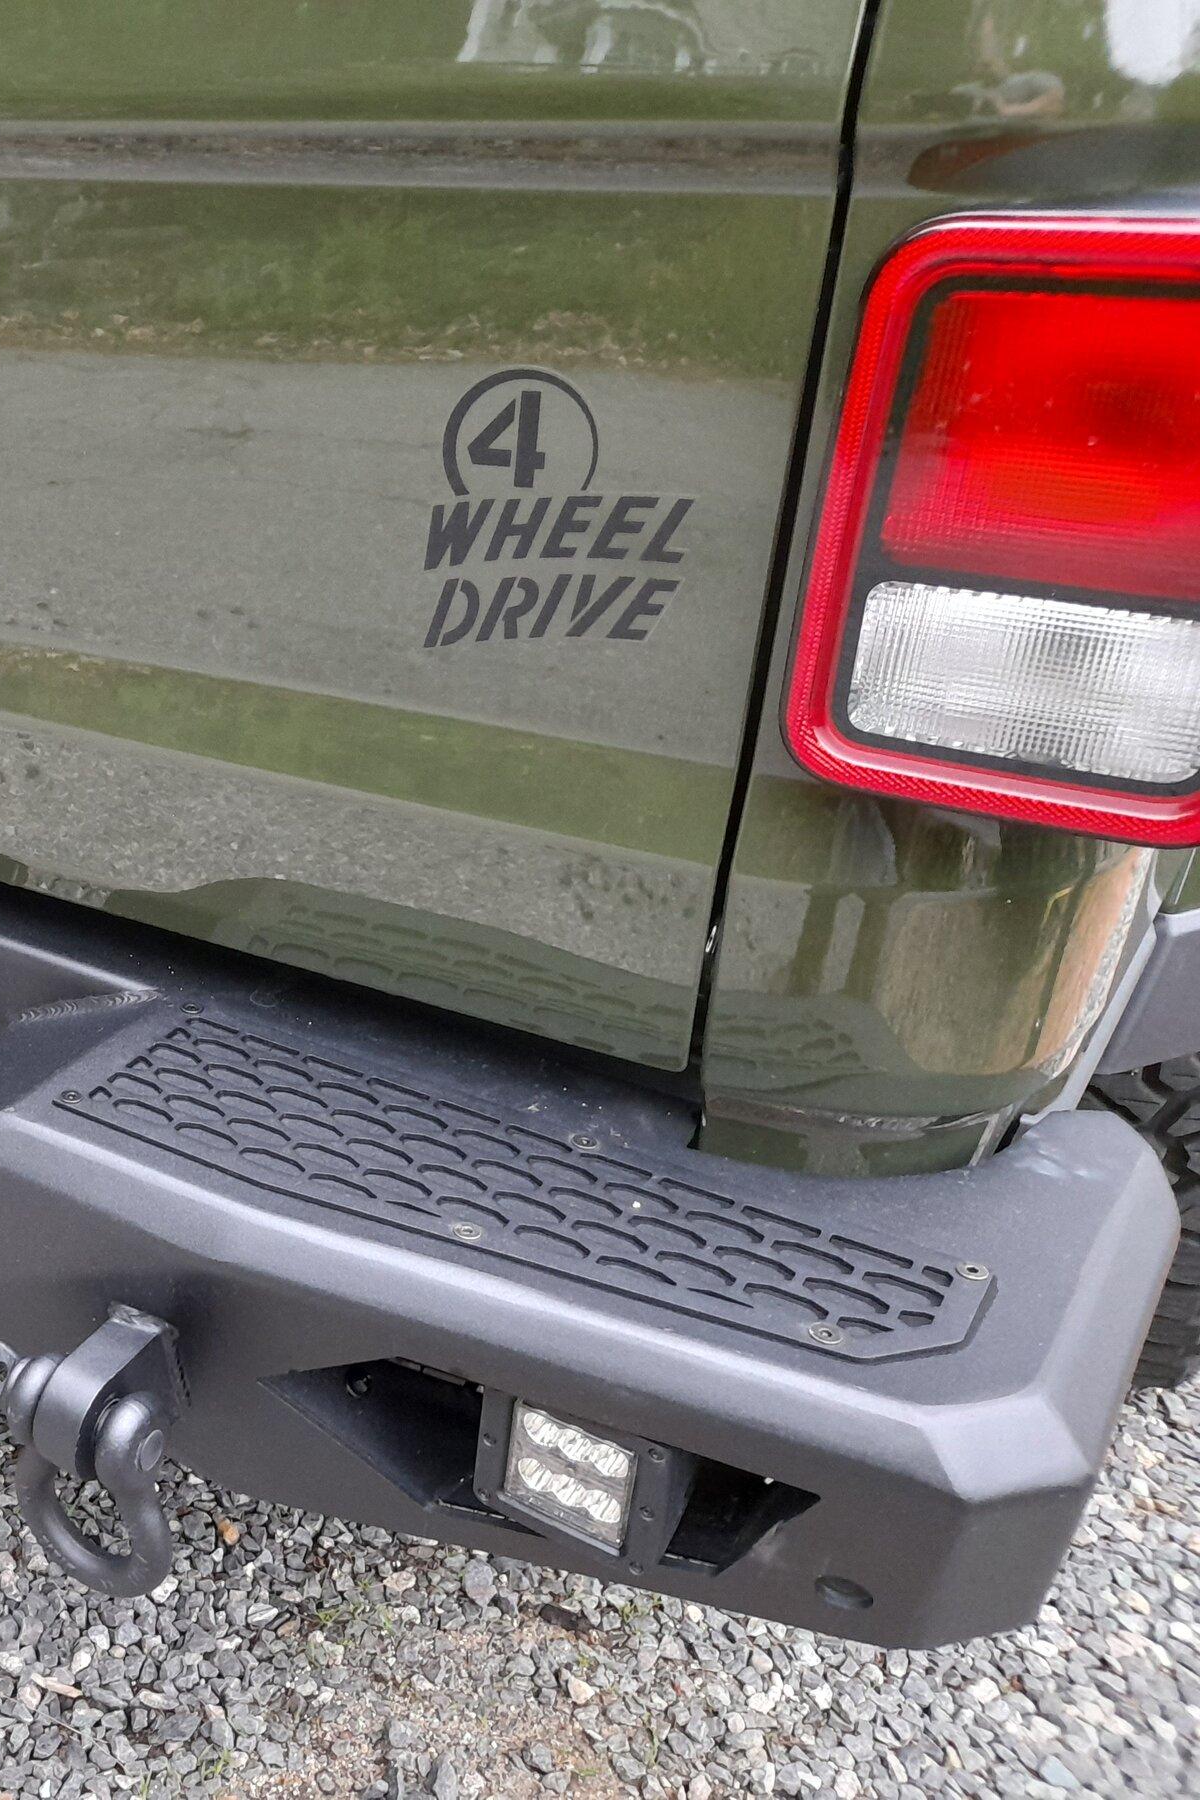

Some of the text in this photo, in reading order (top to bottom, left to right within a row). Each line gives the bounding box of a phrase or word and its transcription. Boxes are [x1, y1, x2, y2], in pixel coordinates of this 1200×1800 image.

[467, 390, 545, 488] 4
[423, 496, 695, 571] WHEEL
[423, 574, 680, 648] DRIVE
